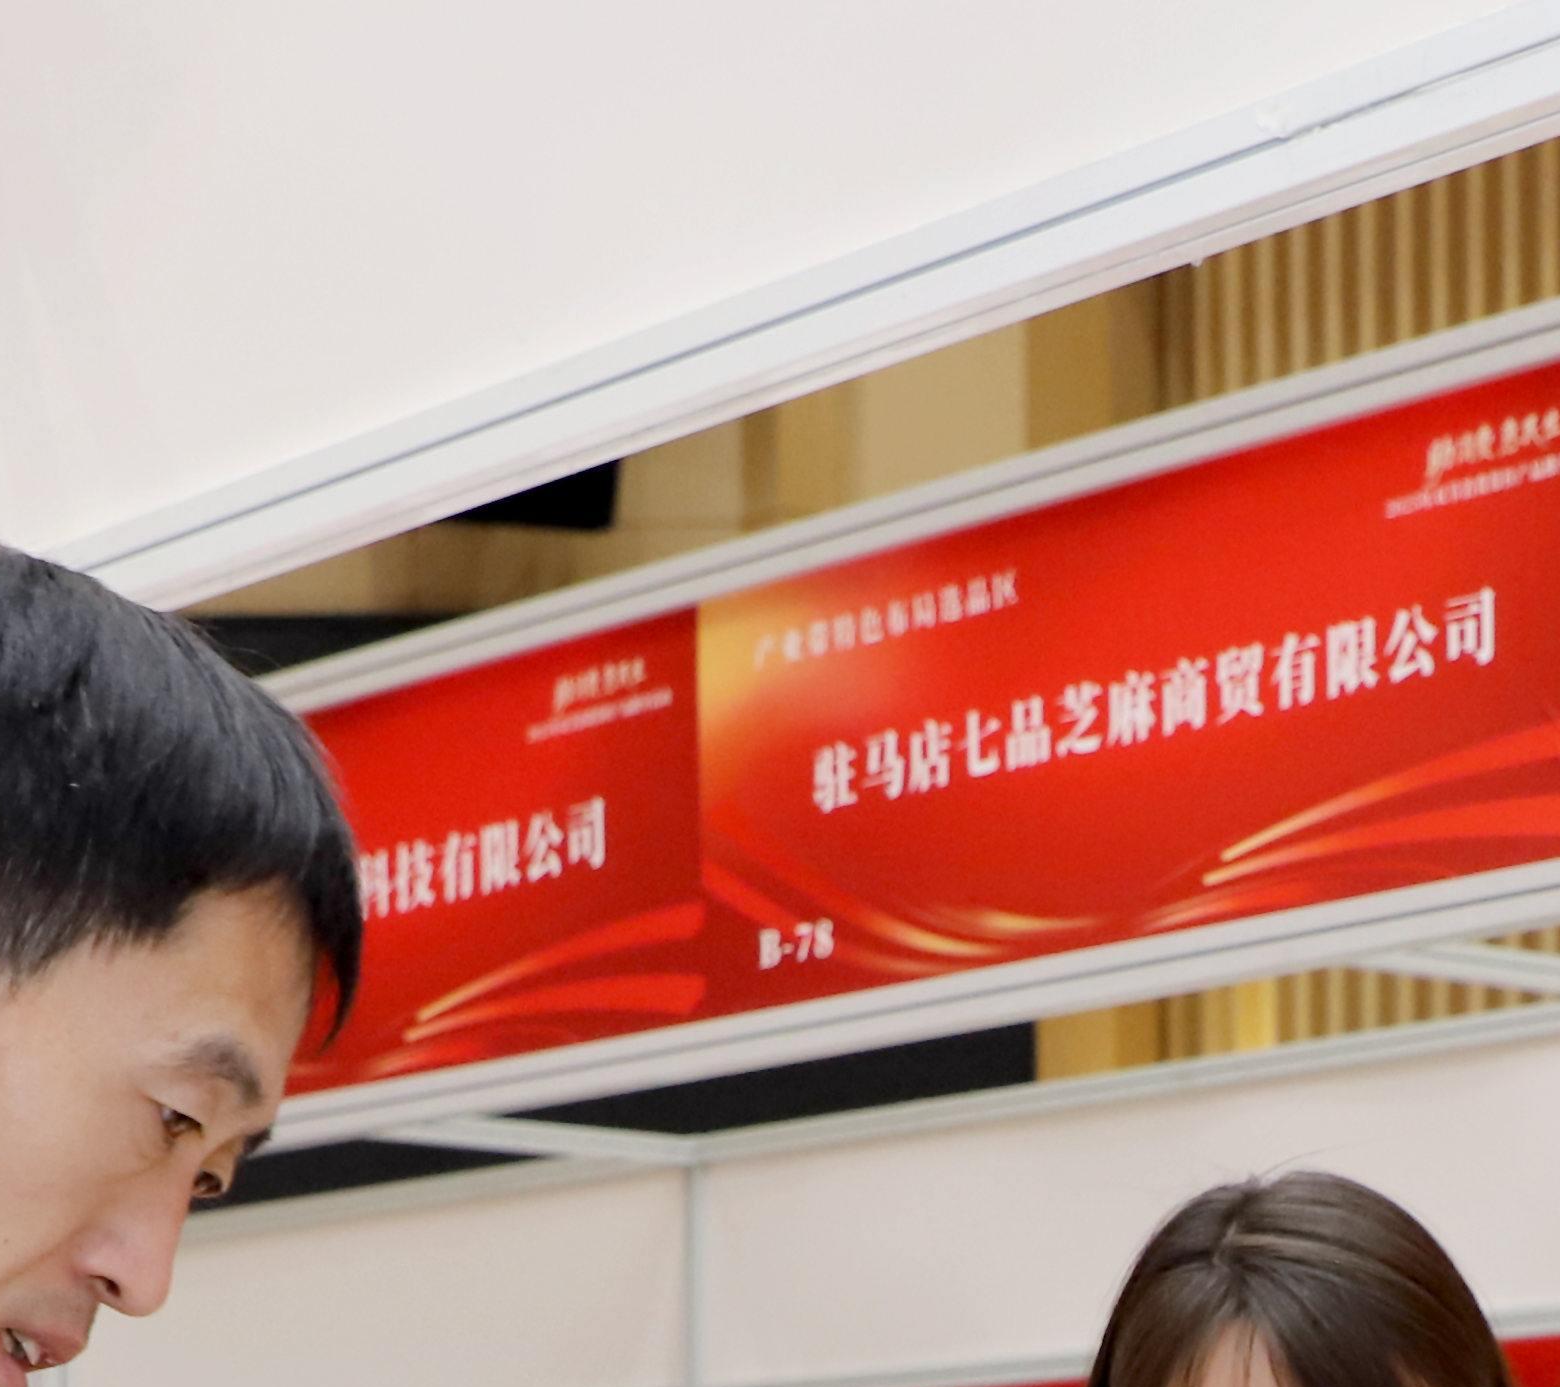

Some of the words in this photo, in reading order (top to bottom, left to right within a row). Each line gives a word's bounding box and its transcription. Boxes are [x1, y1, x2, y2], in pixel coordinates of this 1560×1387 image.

[812, 586, 1497, 814] 驻马店七品芝麻商贸有限公司
[758, 918, 835, 971] B-78
